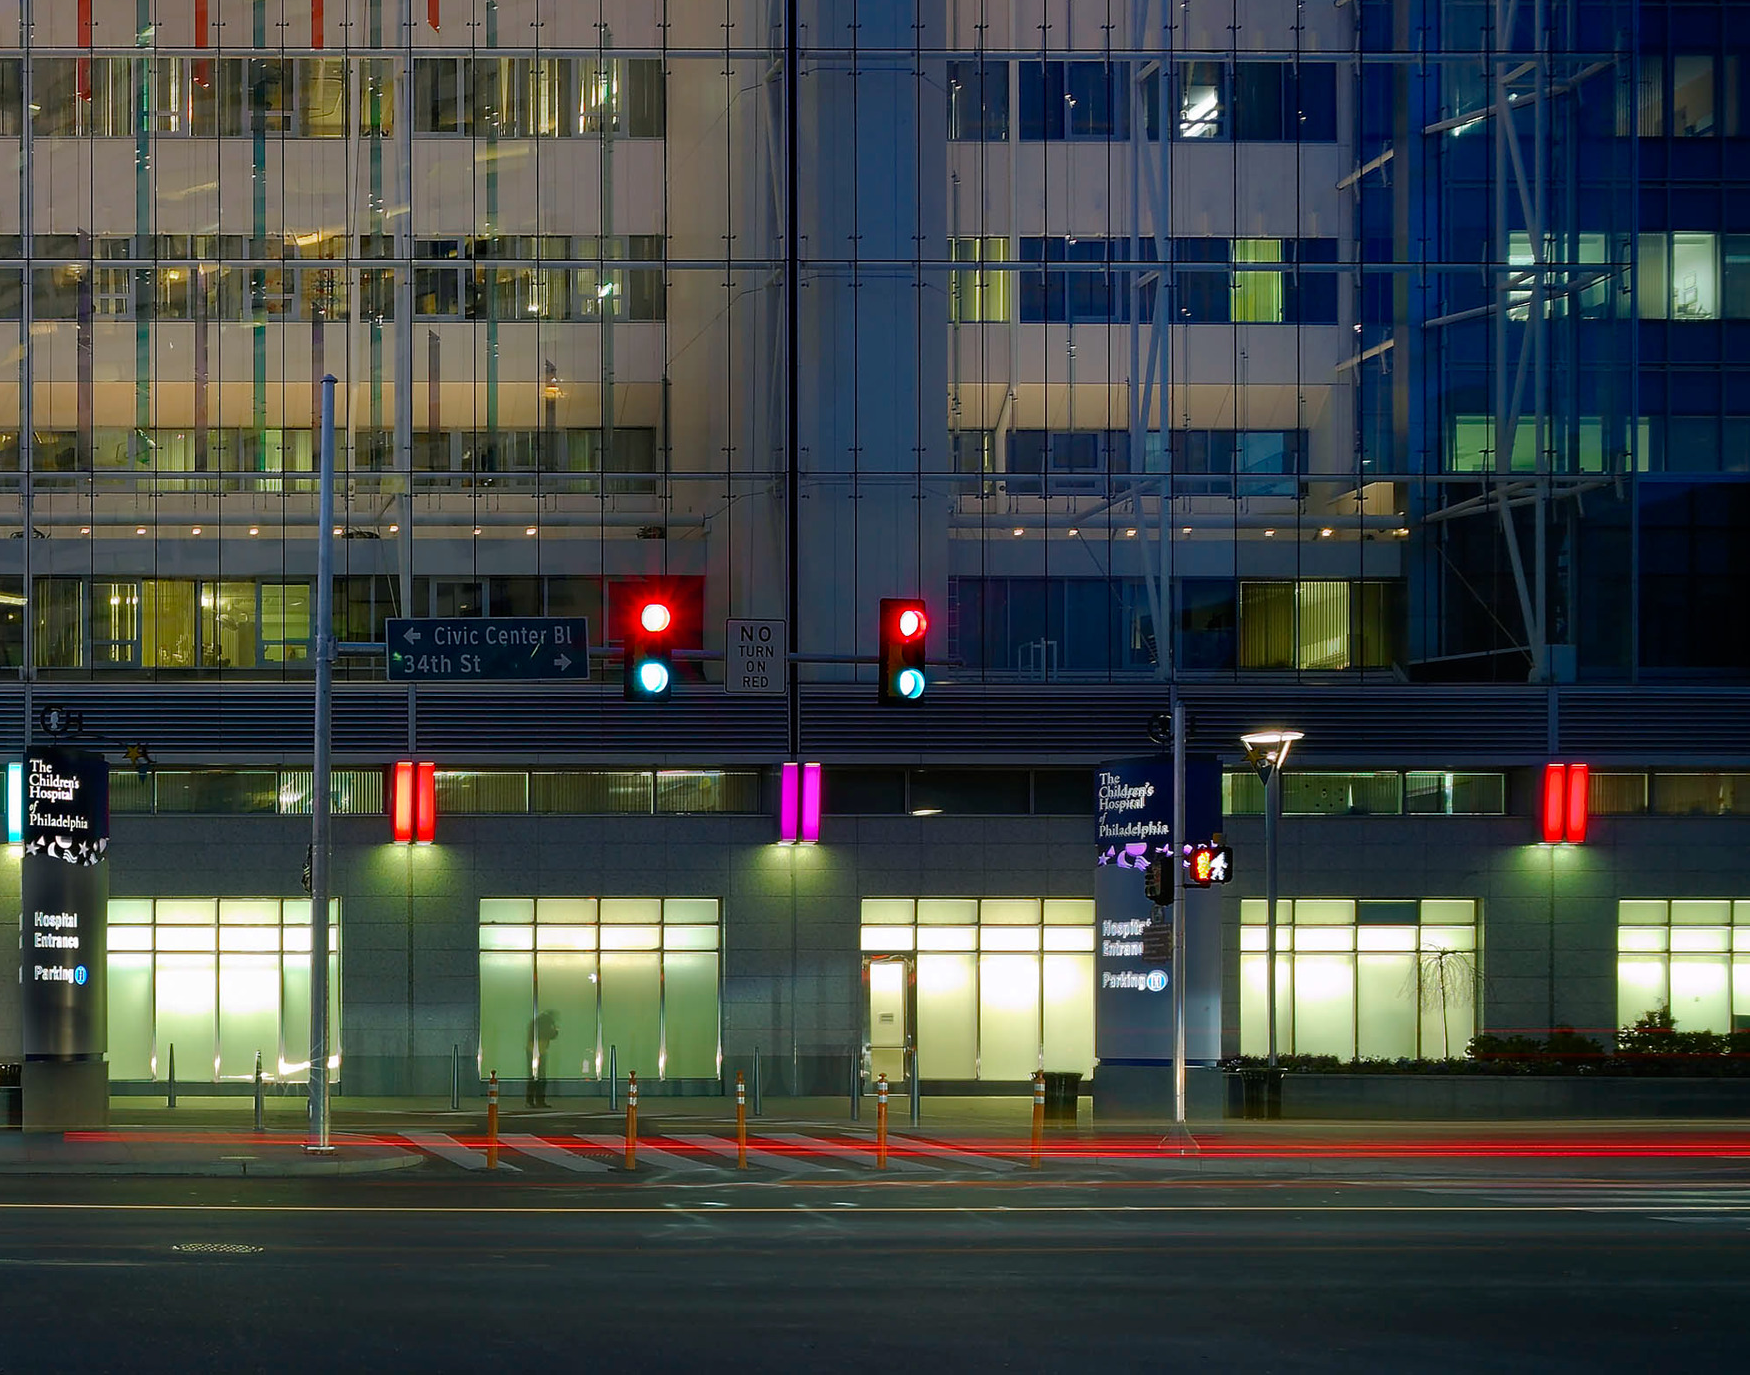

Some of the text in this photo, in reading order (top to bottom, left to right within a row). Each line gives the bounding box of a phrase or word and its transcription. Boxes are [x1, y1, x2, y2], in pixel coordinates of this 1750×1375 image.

[434, 626, 572, 645] Civic Center Bl
[740, 626, 772, 642] NO
[738, 645, 774, 658] TURN
[404, 655, 481, 673] 34th St
[746, 660, 766, 673] ON
[742, 676, 769, 688] RED
[29, 759, 53, 774] The
[29, 773, 80, 789] Children's
[1098, 772, 1121, 785] The
[29, 785, 74, 803] Hospital
[1098, 782, 1155, 798] Children's
[29, 800, 40, 814] of
[1098, 796, 1146, 815] Hospital
[29, 813, 89, 832] Philadelphia
[1098, 821, 1170, 840] Philadelphia
[34, 912, 78, 930] Hospital
[34, 933, 79, 949] Entrance
[34, 965, 75, 984] Parking
[1102, 971, 1147, 991] Parking
